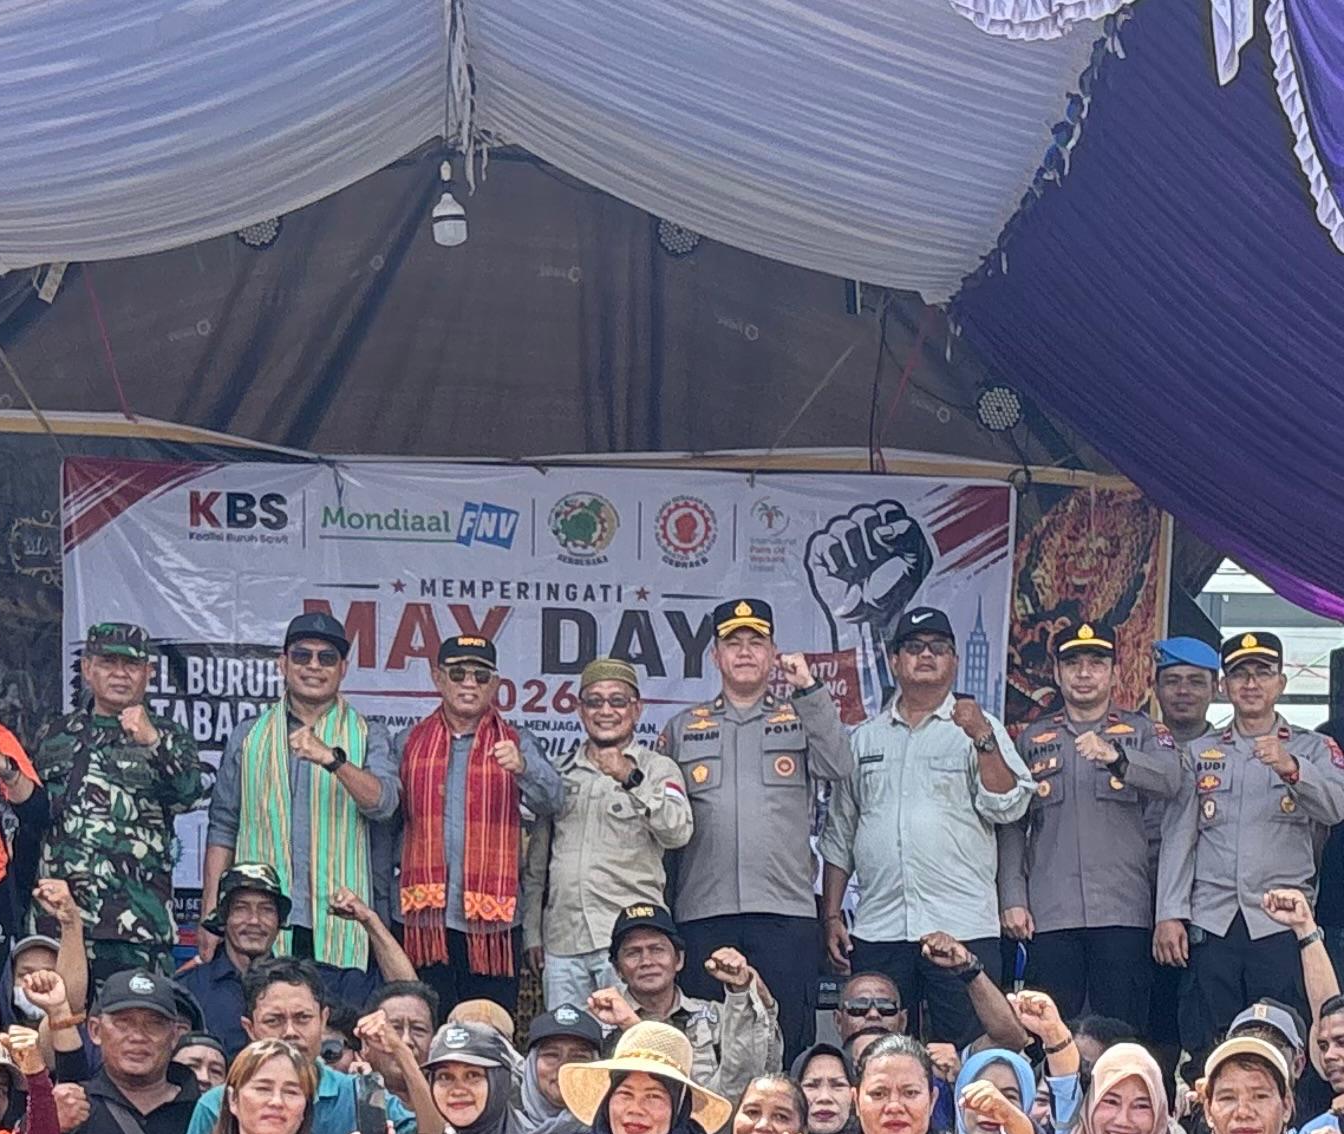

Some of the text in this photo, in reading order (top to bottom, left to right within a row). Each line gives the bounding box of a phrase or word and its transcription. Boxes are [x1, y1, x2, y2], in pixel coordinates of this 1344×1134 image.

[190, 490, 289, 531] KBS
[320, 506, 518, 546] Mondiaal FNV
[420, 578, 623, 603] MEMPERINGATI
[541, 606, 716, 680] DAY
[187, 656, 285, 698] BURUH
[493, 678, 580, 714] 026
[764, 723, 803, 735] POLRI
